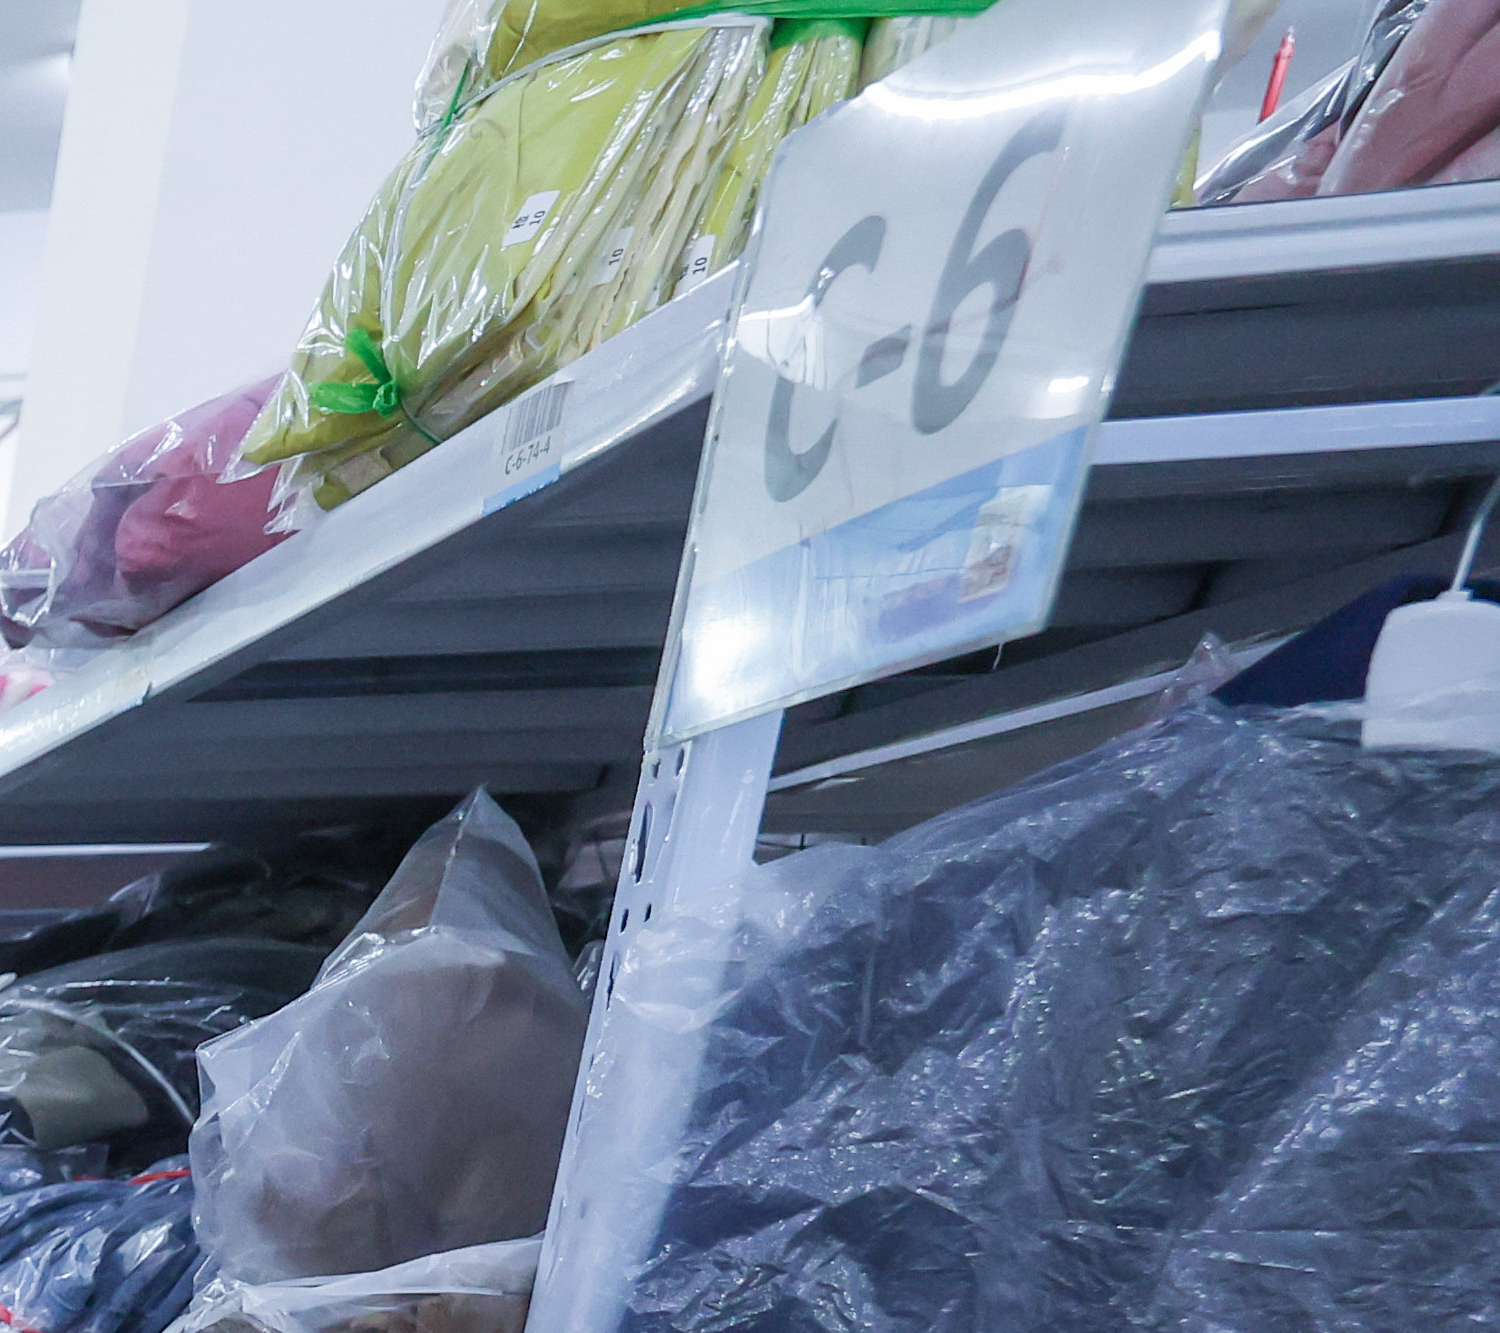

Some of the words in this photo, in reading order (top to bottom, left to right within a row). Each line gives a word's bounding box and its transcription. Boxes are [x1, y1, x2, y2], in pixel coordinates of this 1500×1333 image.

[530, 209, 547, 229] 10
[691, 254, 709, 276] 10
[763, 112, 1069, 503] C-6
